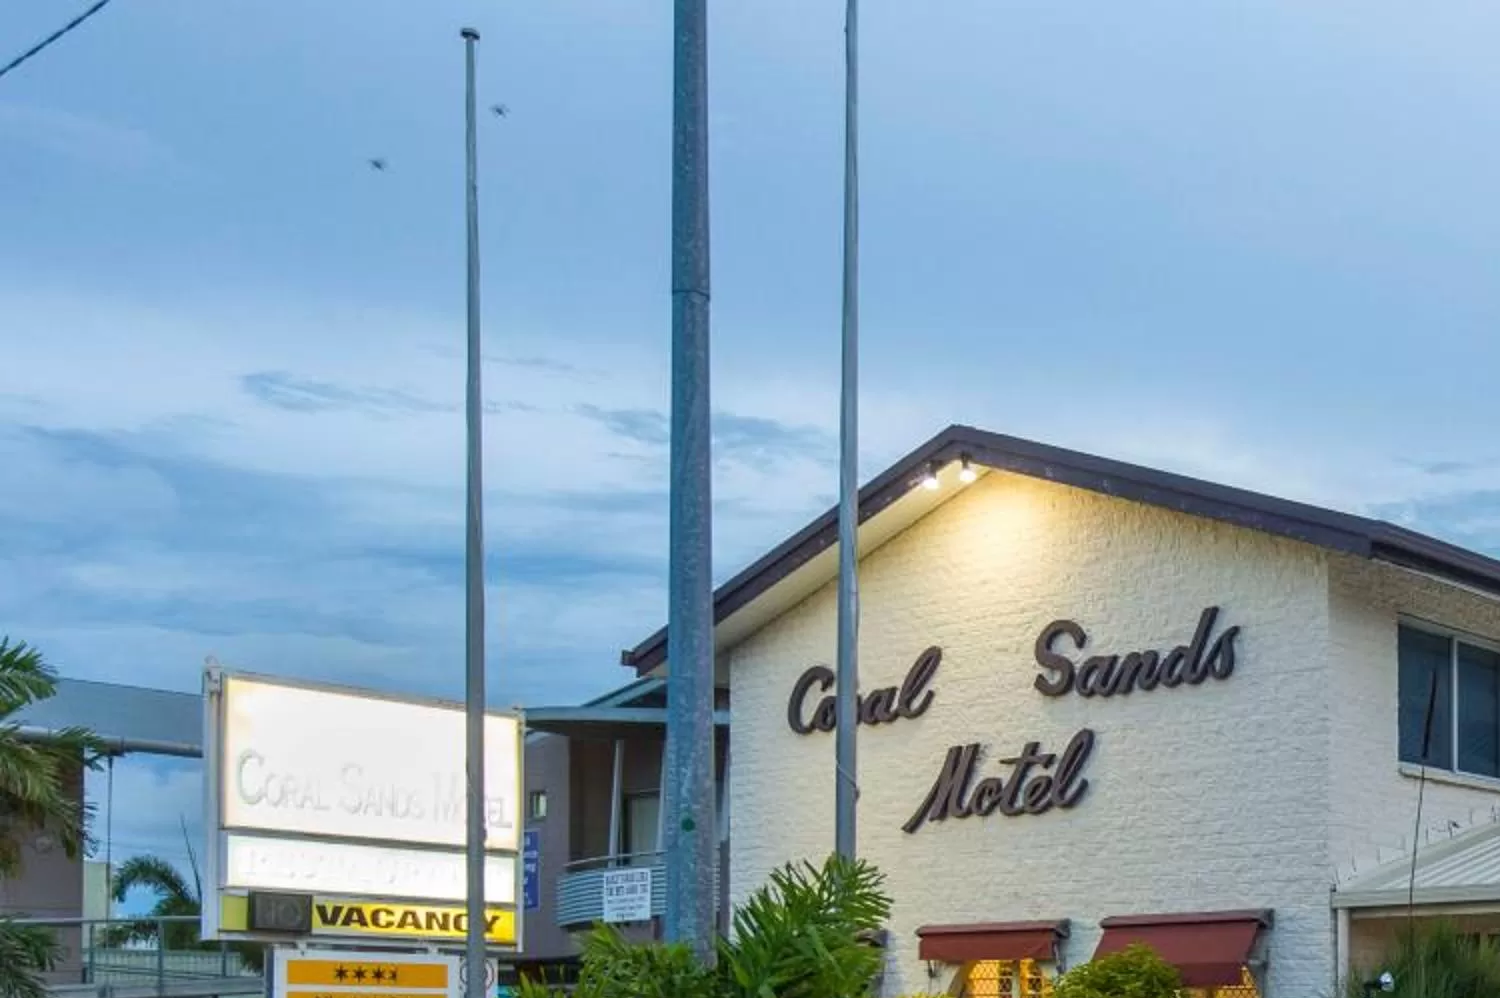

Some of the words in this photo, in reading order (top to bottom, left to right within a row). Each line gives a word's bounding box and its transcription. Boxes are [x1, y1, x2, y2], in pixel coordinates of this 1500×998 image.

[787, 646, 943, 735] Coal
[1034, 606, 1240, 698] Sands
[235, 747, 333, 811] CORAL
[337, 762, 425, 819] SANDS
[902, 728, 1095, 834] Motel
